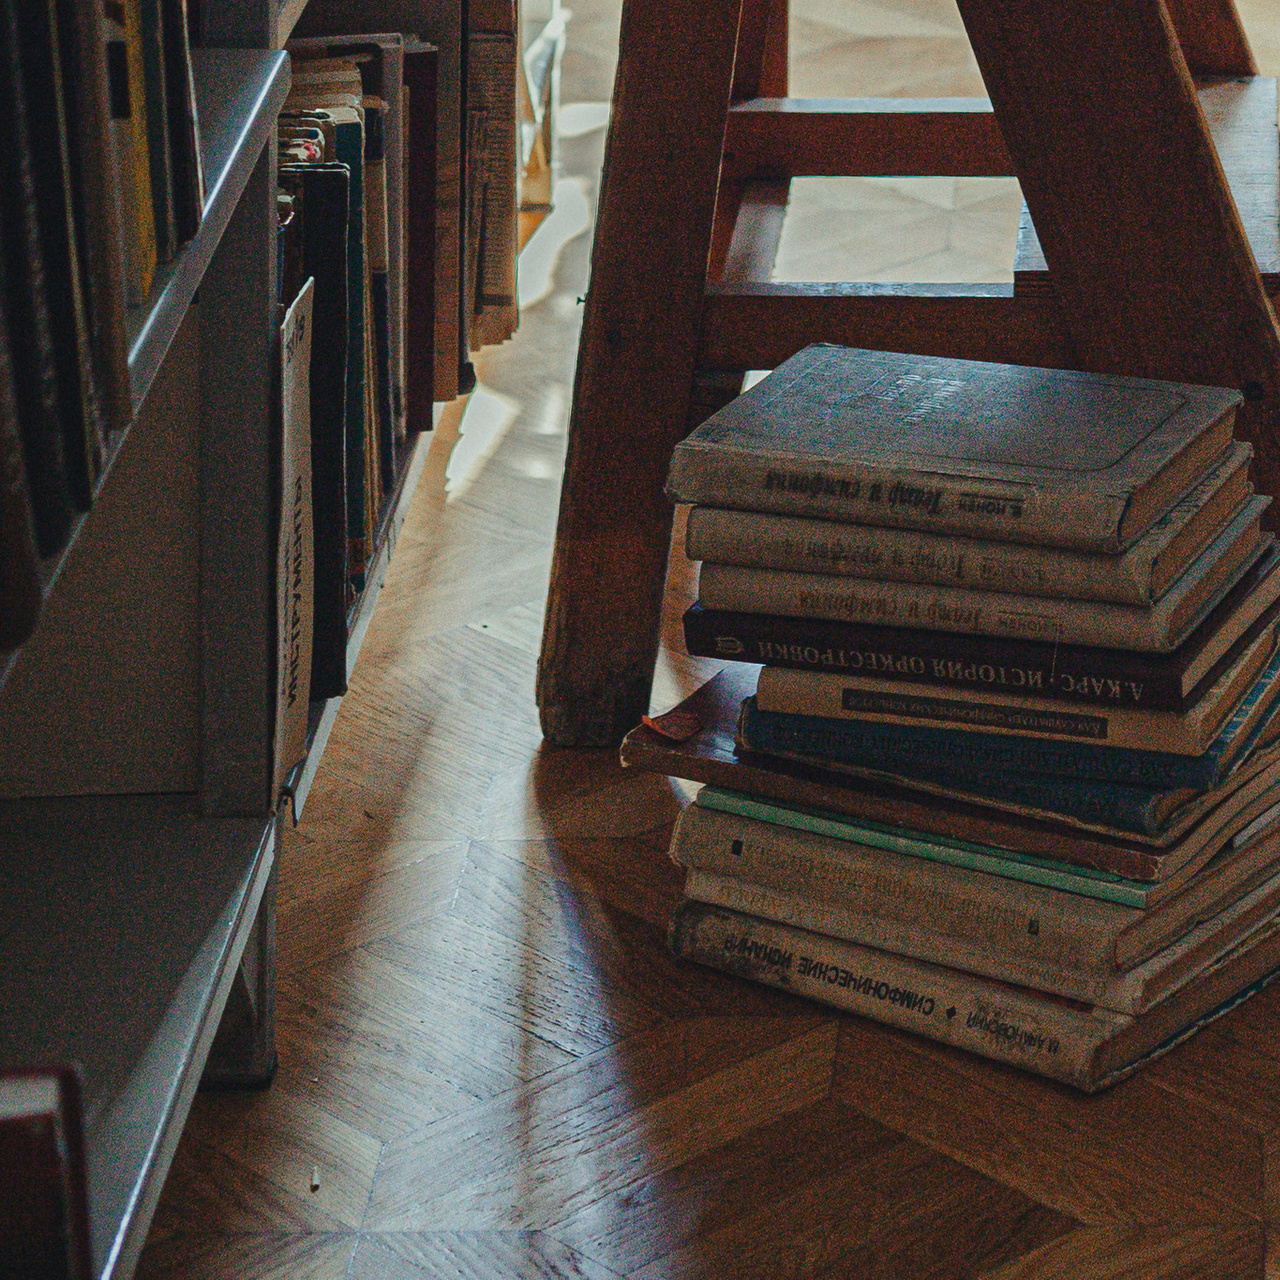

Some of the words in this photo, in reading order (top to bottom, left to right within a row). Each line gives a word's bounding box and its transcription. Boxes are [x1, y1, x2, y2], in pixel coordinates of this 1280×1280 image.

[868, 483, 882, 503] и
[755, 634, 926, 678] ОРКЕСТРОВКИ
[929, 655, 1044, 691] ИСТОРИЯ
[1058, 671, 1144, 702] А.КАРС
[721, 930, 794, 972] ИСКАНИЯ
[794, 951, 937, 1019] СИМФОНИЧЕСКИЕ
